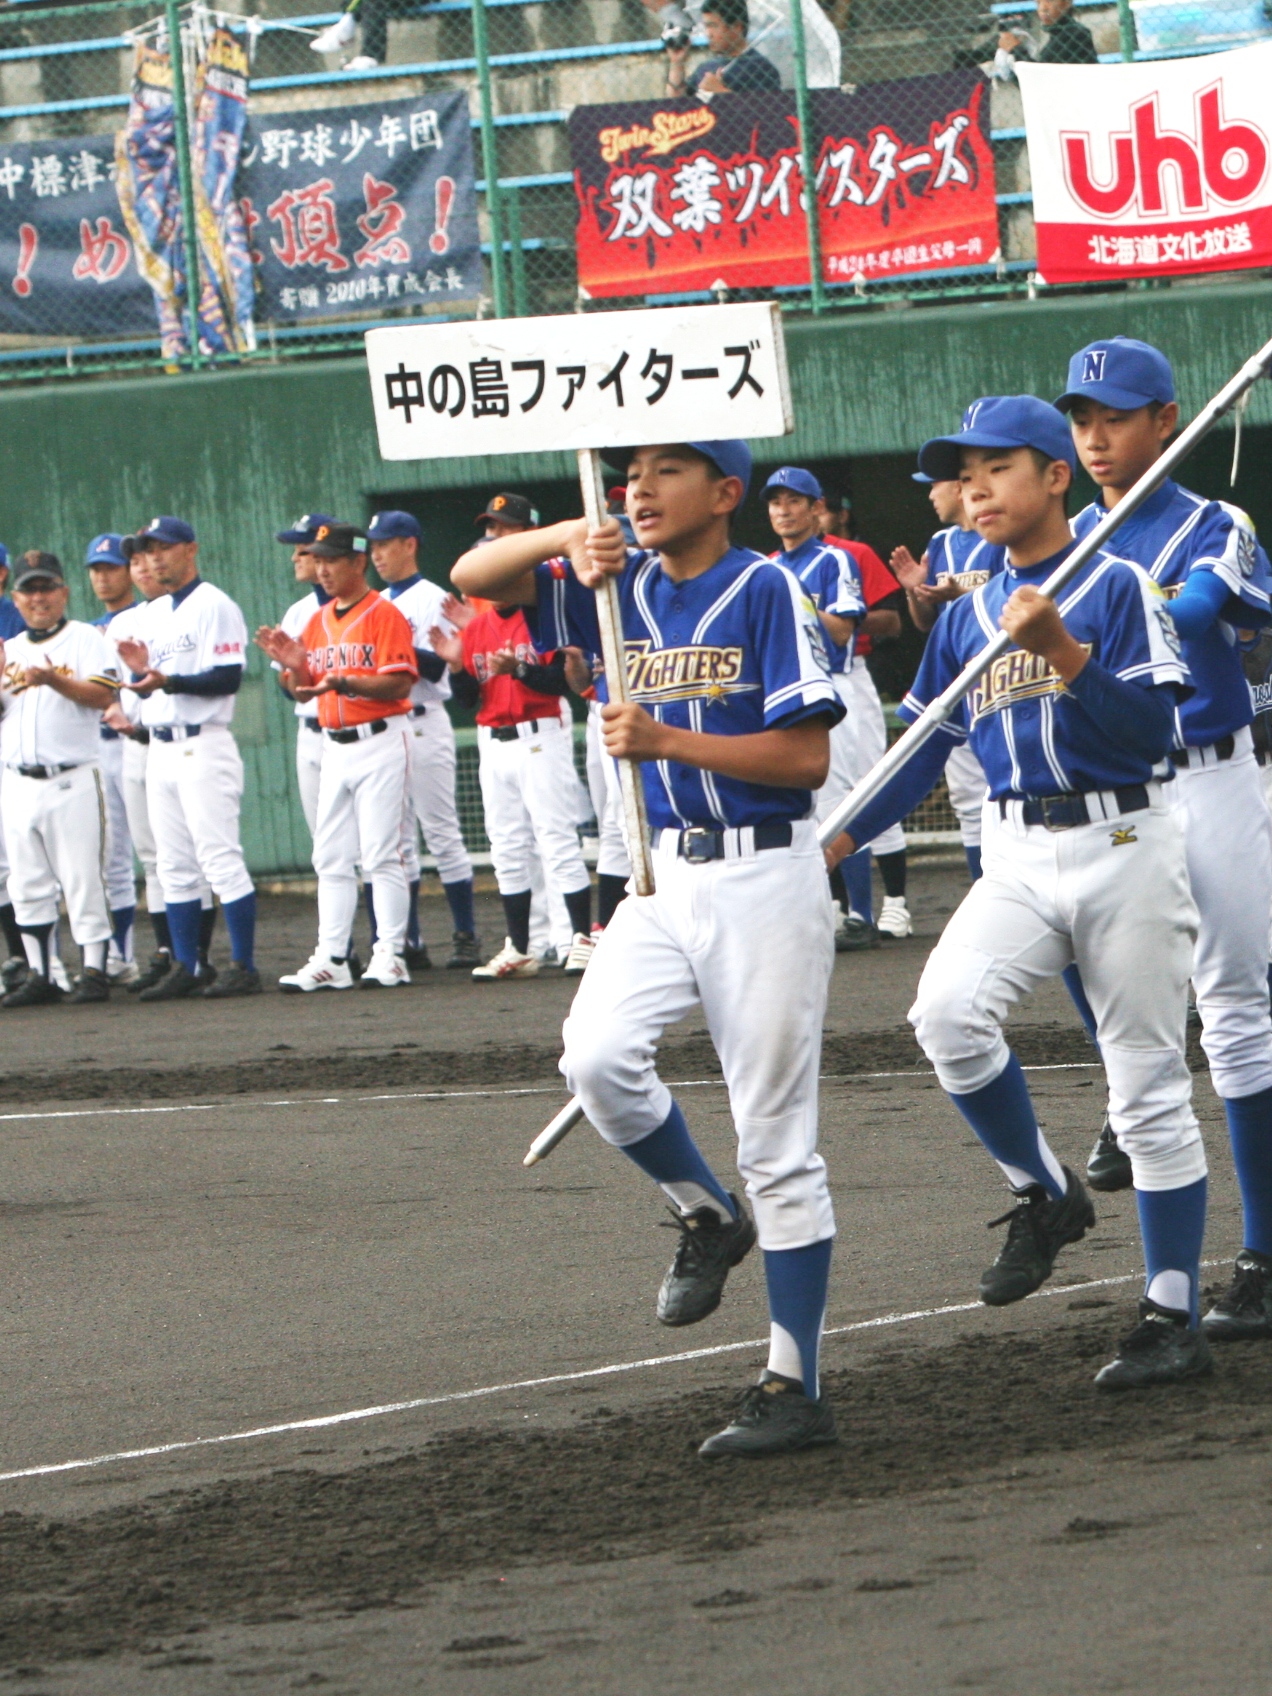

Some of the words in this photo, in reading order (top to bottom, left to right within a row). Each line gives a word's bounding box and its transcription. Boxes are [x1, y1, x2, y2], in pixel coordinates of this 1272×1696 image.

[1061, 79, 1268, 218] uhb
[0, 150, 118, 200] 中標津
[1088, 221, 1252, 265] 北海道文化放送
[384, 339, 764, 424] 中の島ファイターズ
[1082, 351, 1107, 383] N
[493, 495, 507, 510] P
[315, 525, 330, 541] P
